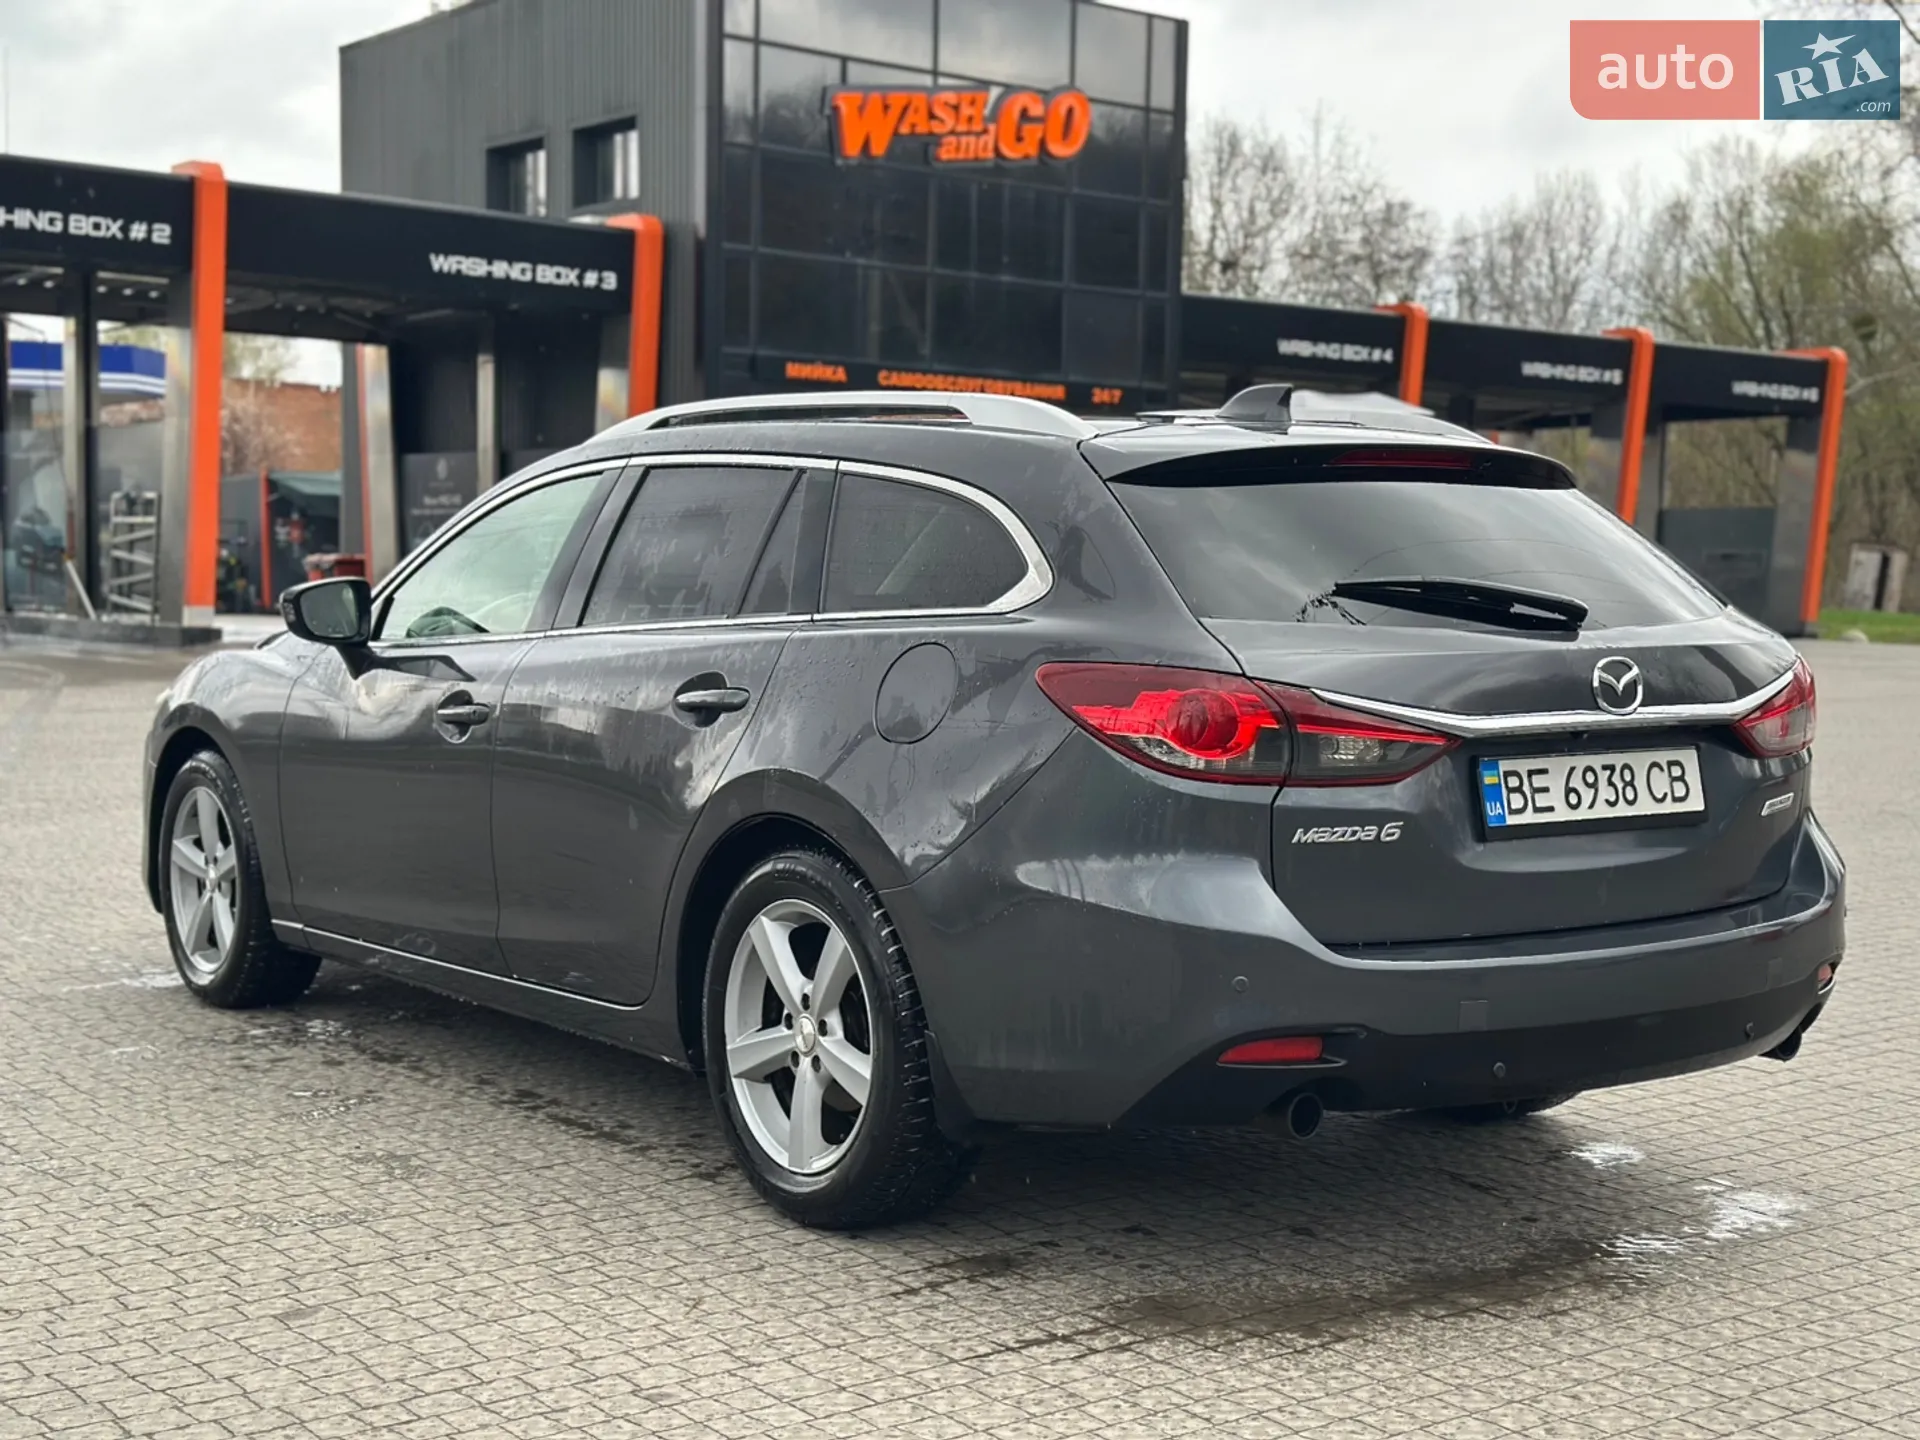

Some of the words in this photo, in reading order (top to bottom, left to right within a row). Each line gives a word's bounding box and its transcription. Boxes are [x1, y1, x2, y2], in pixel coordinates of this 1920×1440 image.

[936, 123, 997, 161] and
[996, 90, 1092, 160] GO
[67, 213, 124, 240] BOX
[429, 252, 533, 282] WASHING
[535, 263, 580, 287] BOX
[1502, 767, 1555, 816] BE
[1564, 762, 1639, 811] 6938
[1645, 759, 1690, 804] CB
[1486, 801, 1504, 817] UA
